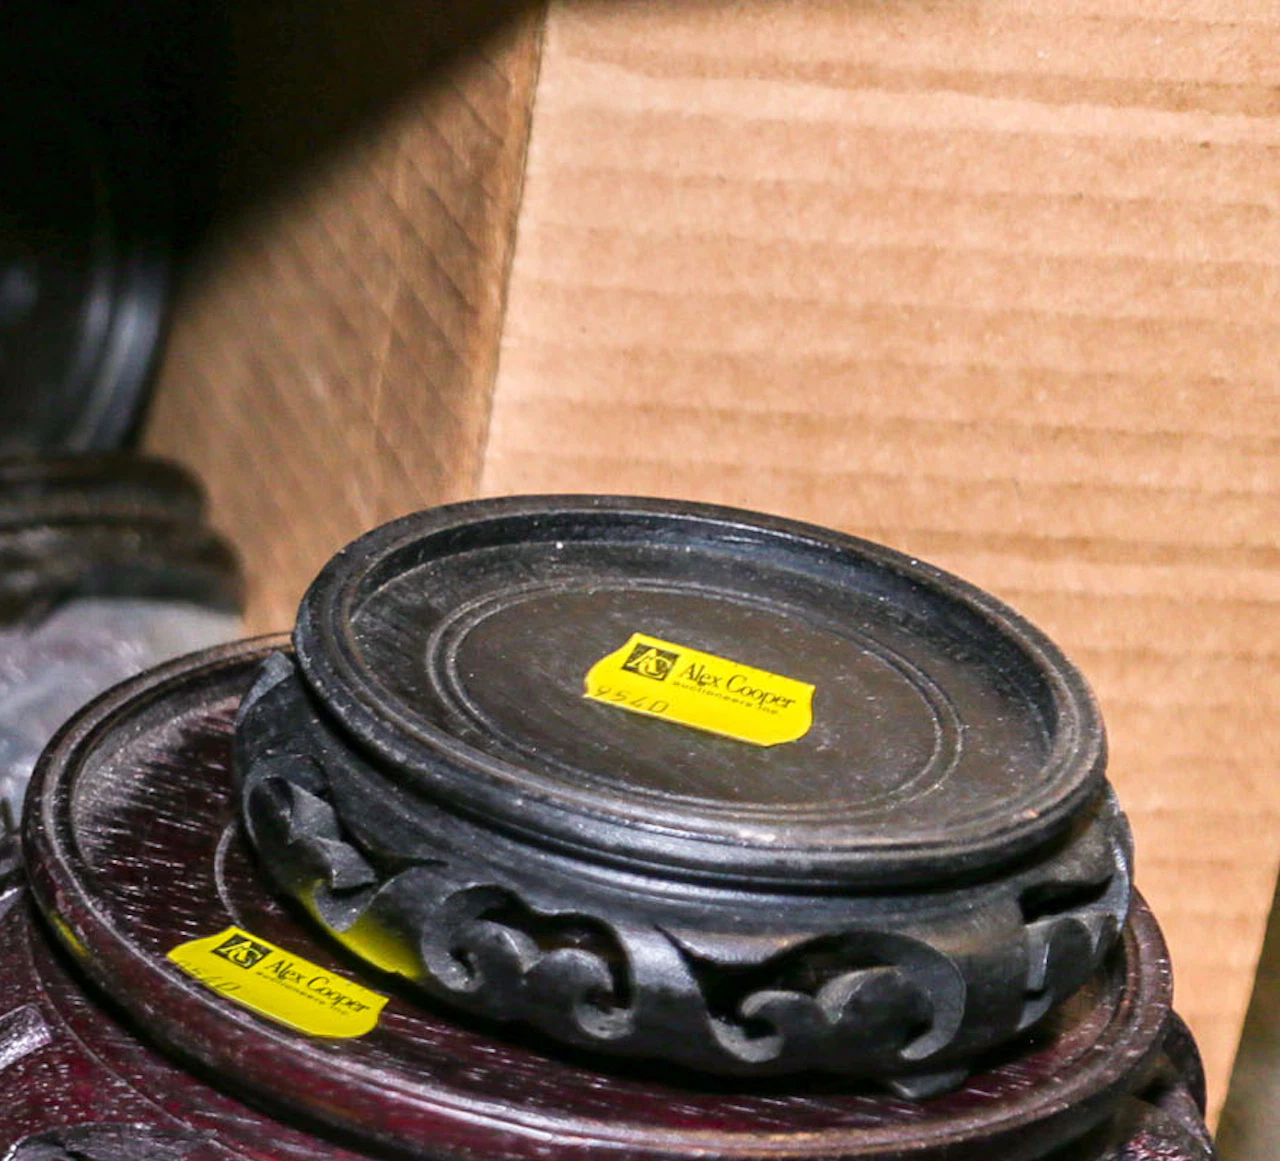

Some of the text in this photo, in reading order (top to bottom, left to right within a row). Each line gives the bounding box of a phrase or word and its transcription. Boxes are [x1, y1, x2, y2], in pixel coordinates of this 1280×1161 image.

[679, 661, 796, 709] Alex Cooper
[265, 959, 306, 985] Alex
[307, 976, 371, 1012] Cooper
